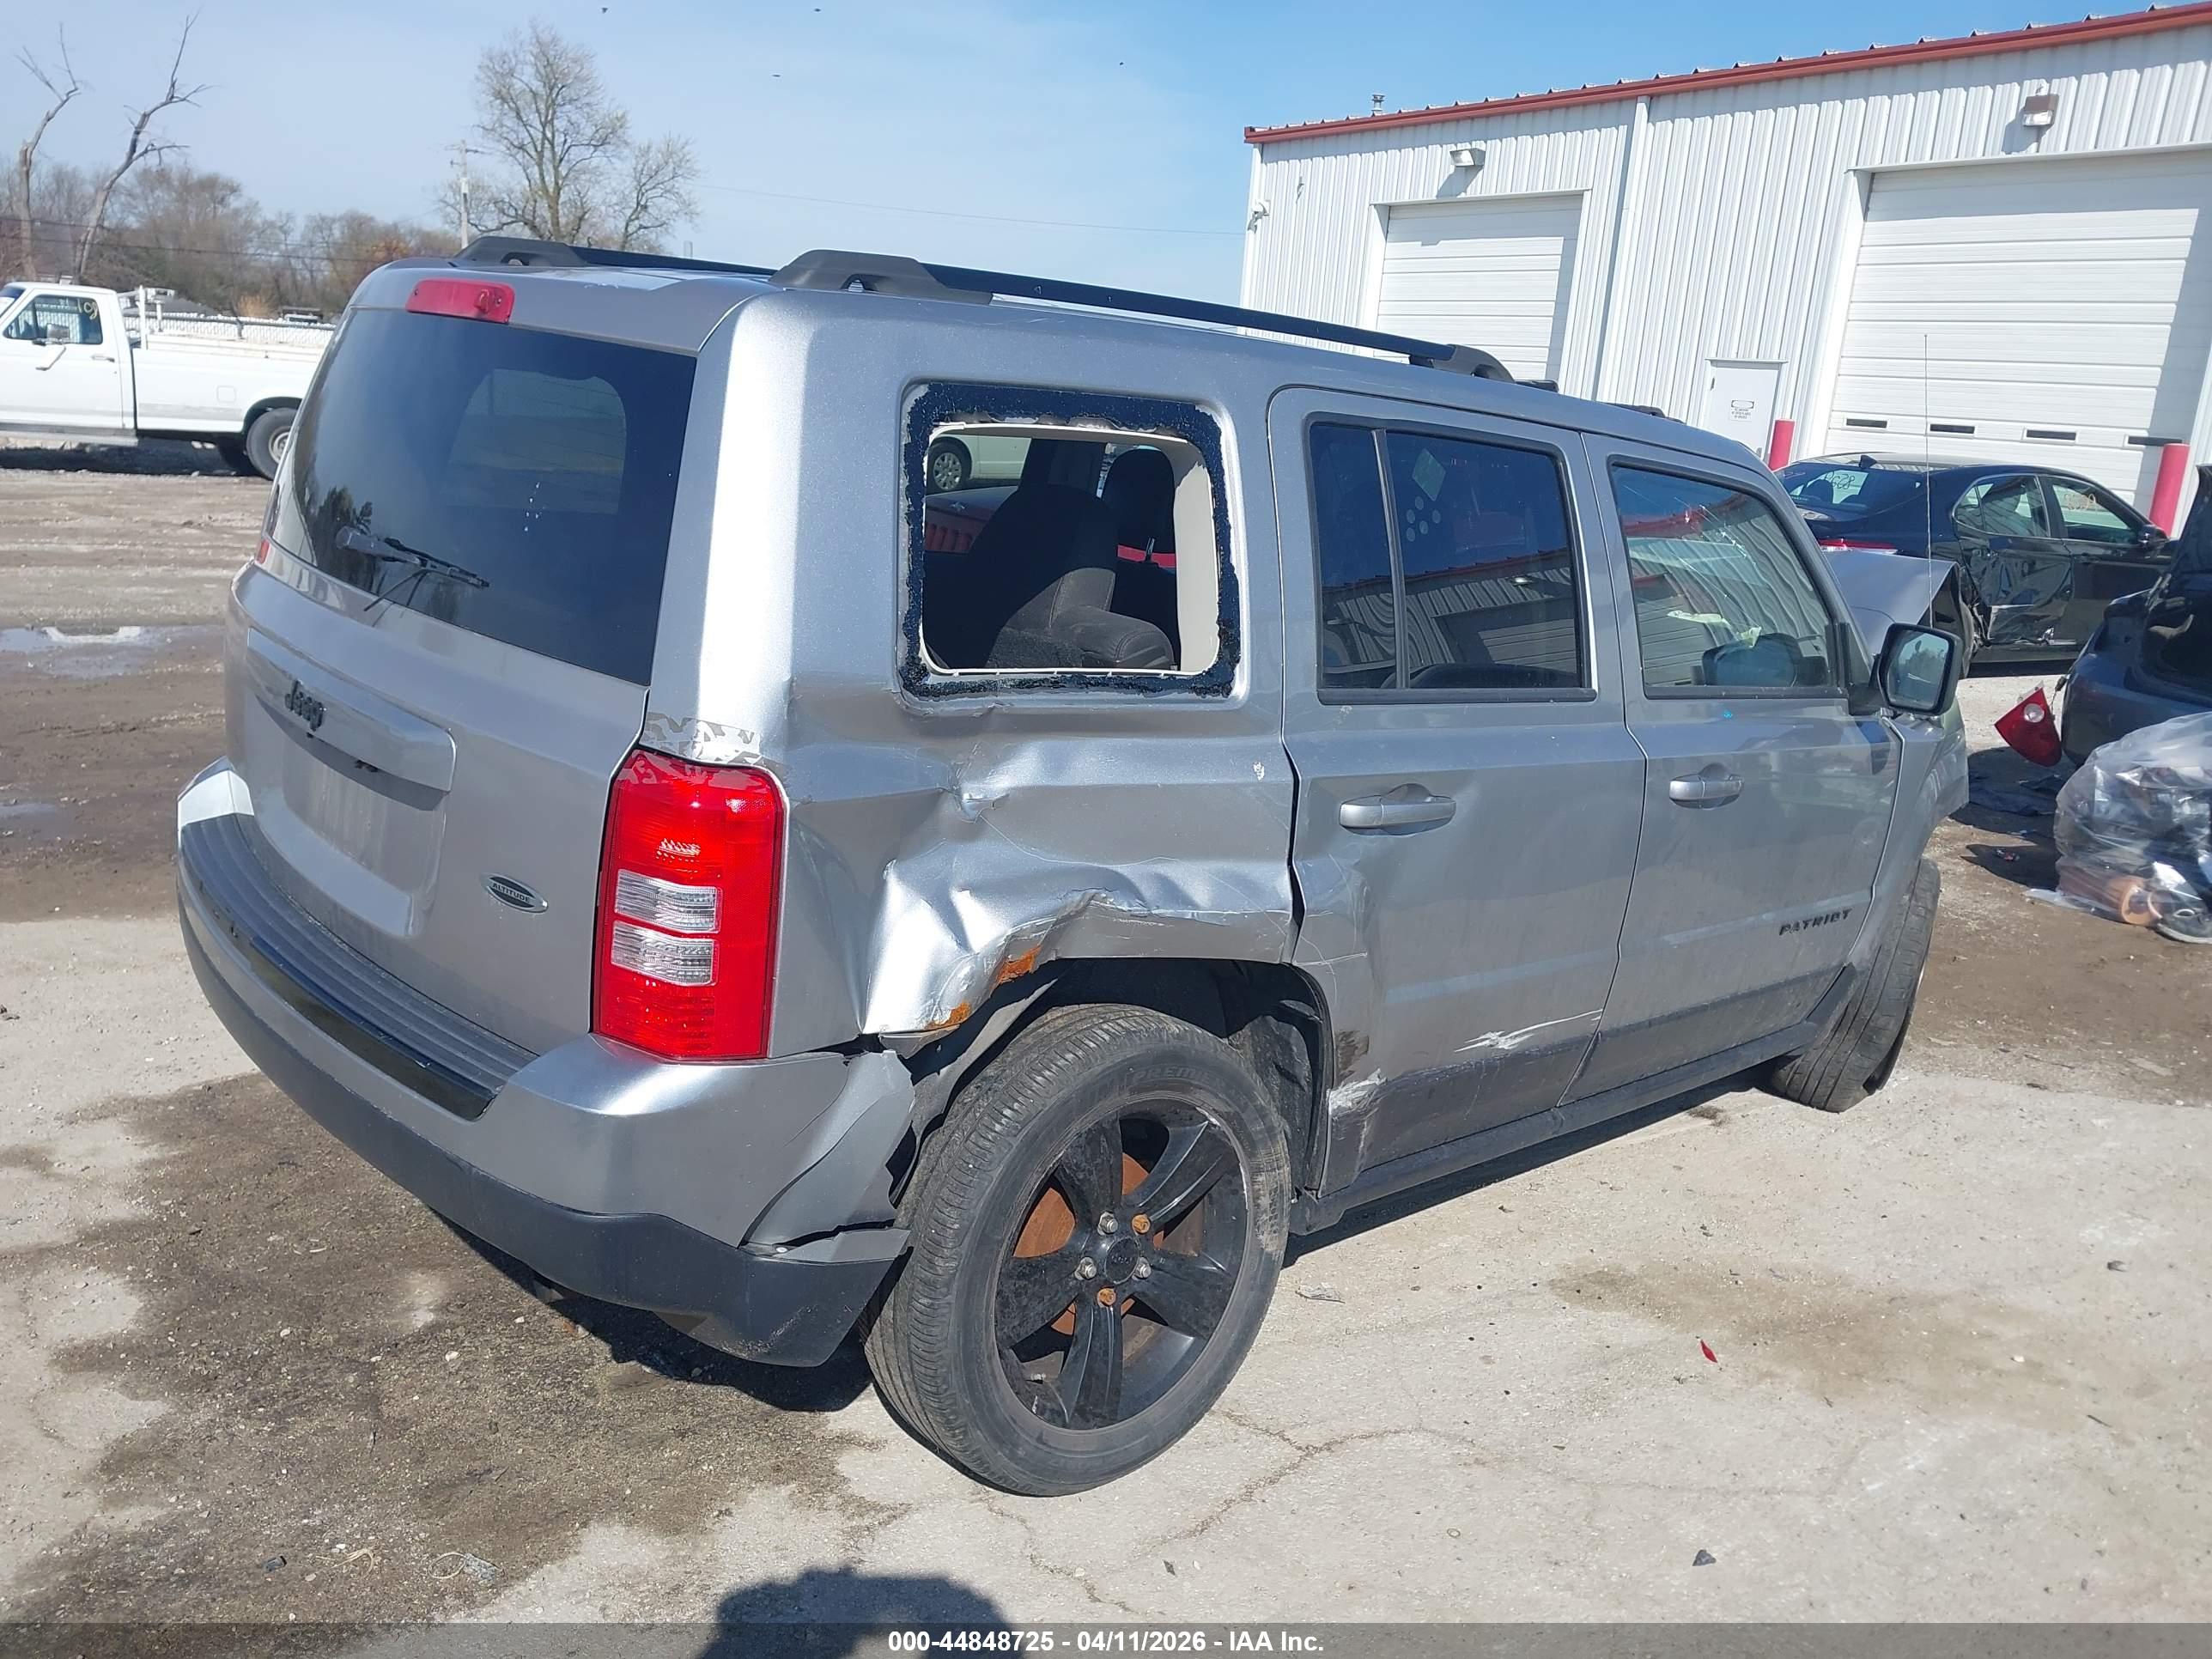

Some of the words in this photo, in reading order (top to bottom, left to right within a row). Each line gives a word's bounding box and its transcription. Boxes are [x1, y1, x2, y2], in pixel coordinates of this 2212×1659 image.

[284, 679, 325, 732] Jeep
[492, 882, 531, 903] ALTITUDE
[1779, 908, 1853, 935] PATRIOT
